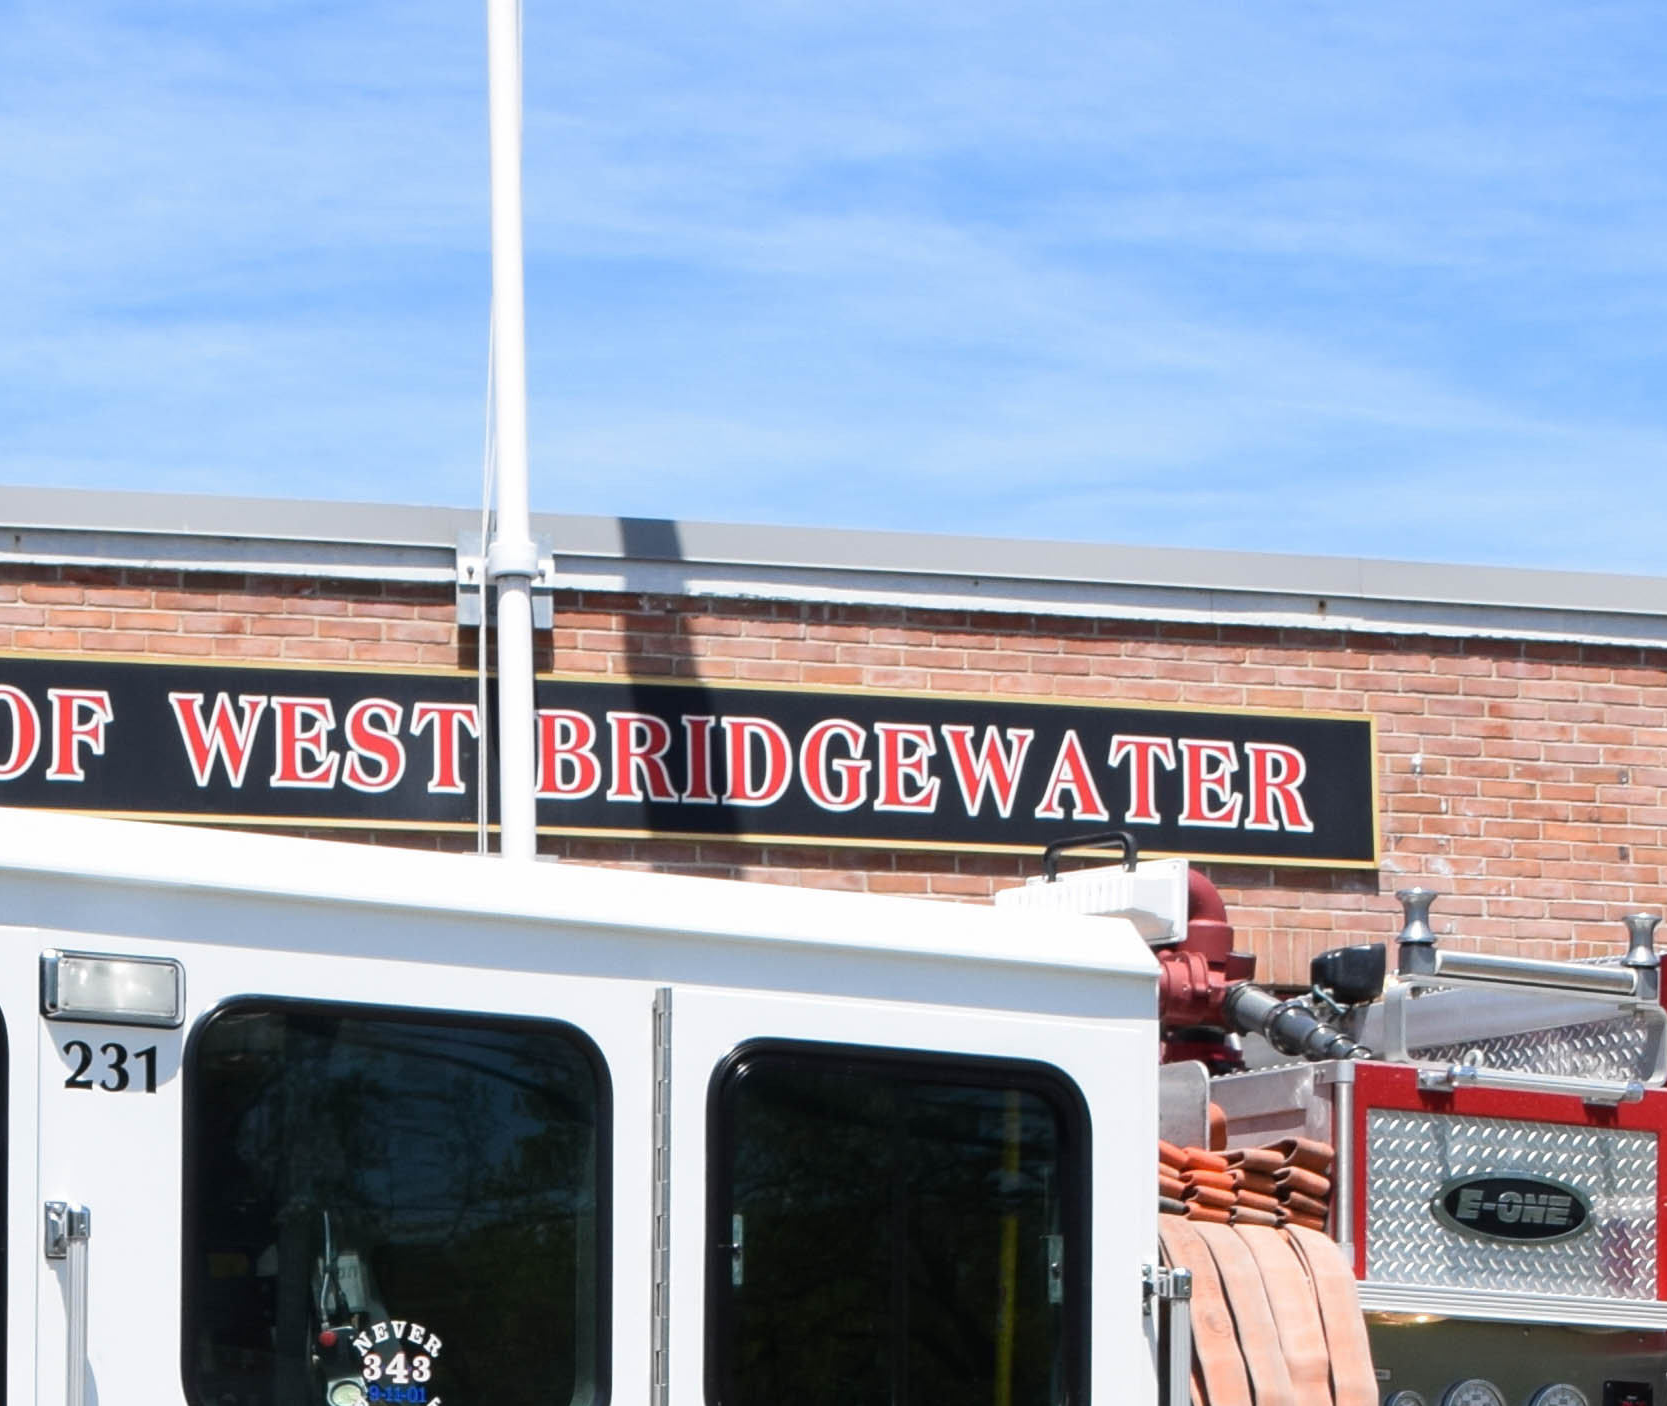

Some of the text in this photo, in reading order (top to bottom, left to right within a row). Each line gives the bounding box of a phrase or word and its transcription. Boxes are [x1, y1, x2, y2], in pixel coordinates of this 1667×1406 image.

[169, 692, 480, 794] WEST
[534, 708, 1313, 833] BRIDGEWATER
[63, 1041, 158, 1093] 231
[1456, 1188, 1573, 1225] E-ONE
[353, 1321, 443, 1357] NEVER
[363, 1352, 432, 1384] 343
[368, 1385, 427, 1404] 9-11-01
